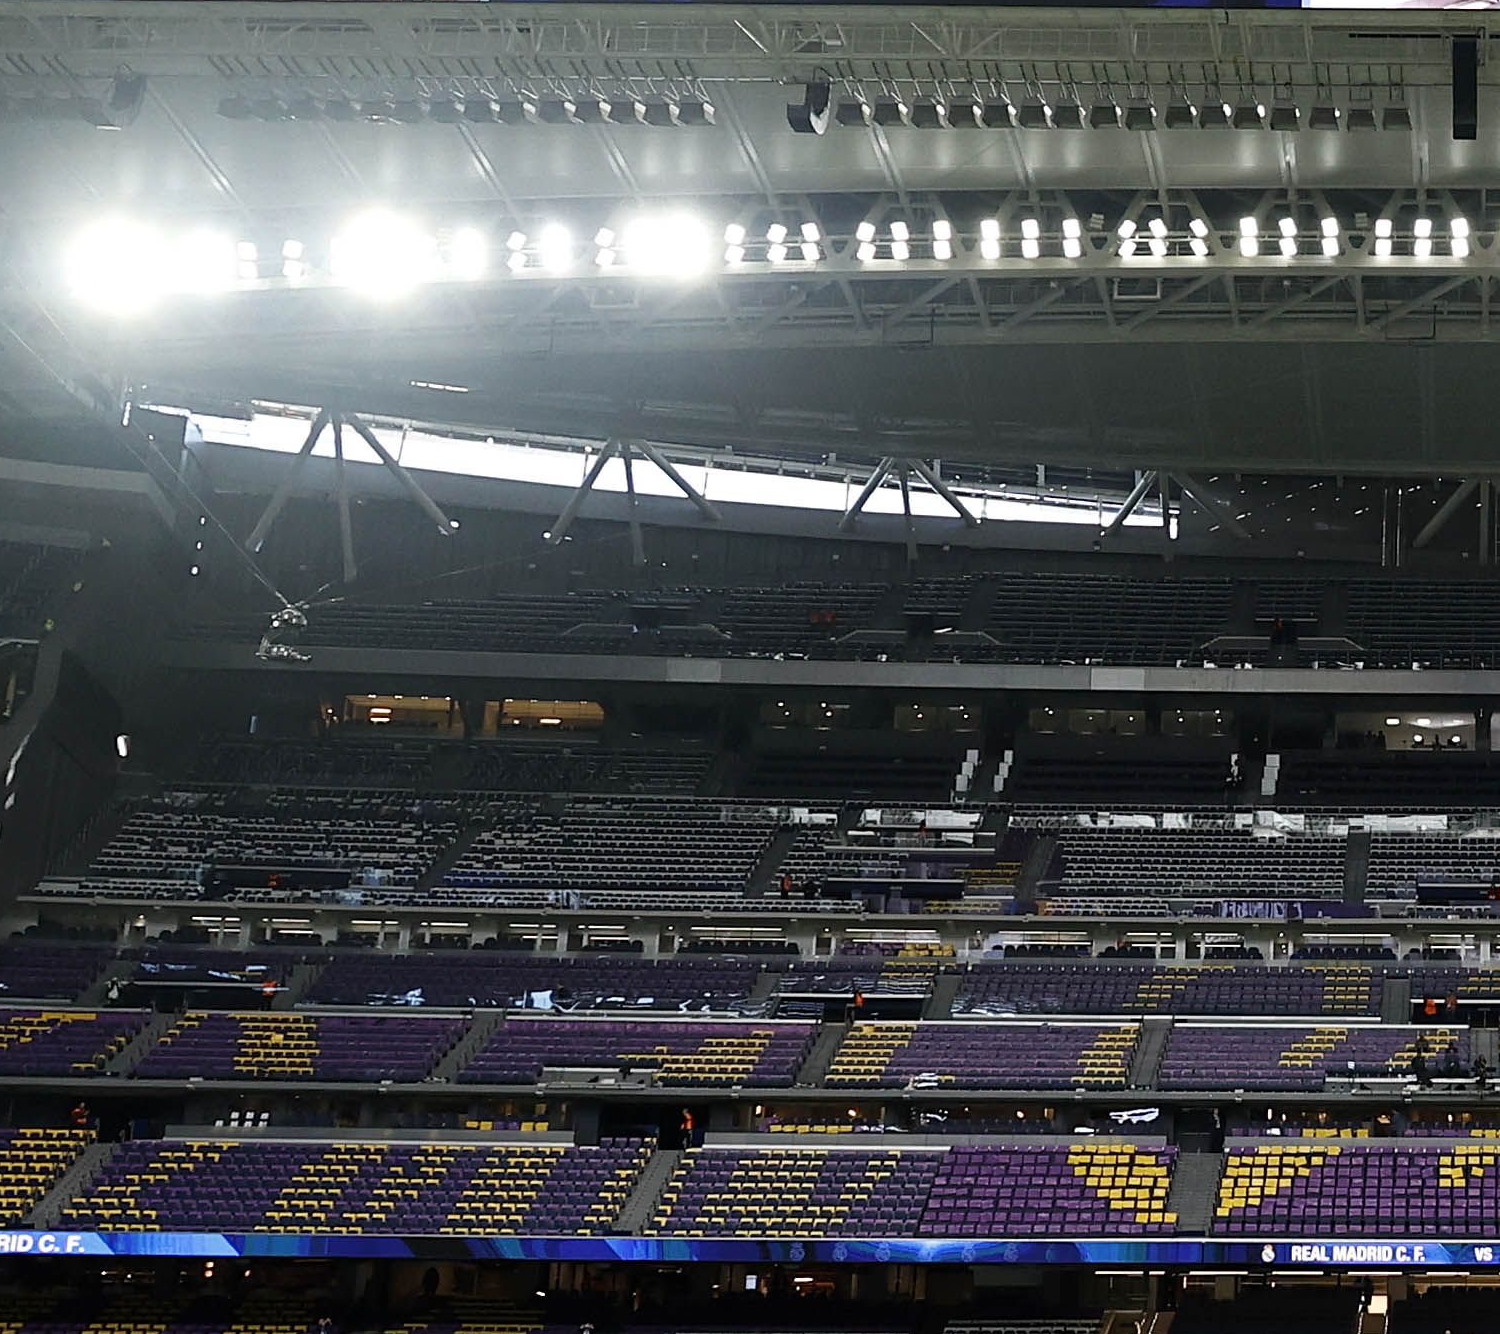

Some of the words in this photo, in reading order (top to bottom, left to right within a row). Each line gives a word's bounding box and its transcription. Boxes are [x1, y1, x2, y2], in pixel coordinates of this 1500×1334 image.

[38, 1234, 60, 1253] C.
[66, 1235, 85, 1253] F.
[1291, 1245, 1329, 1262] REAL
[1333, 1245, 1393, 1262] MADRID
[1474, 1246, 1493, 1262] VS
